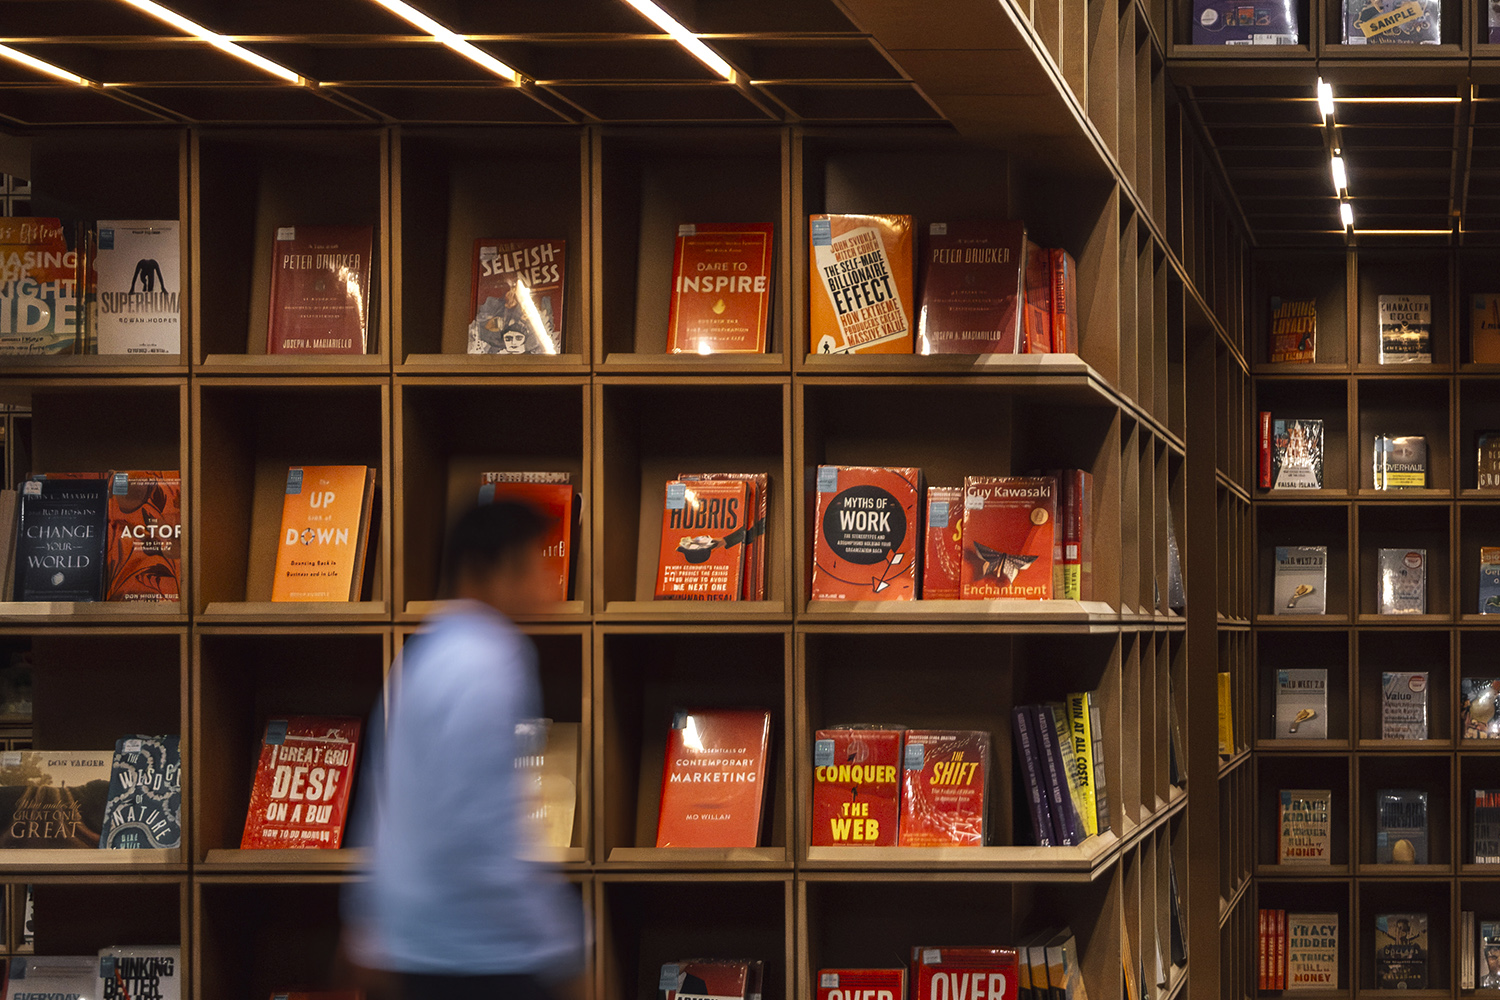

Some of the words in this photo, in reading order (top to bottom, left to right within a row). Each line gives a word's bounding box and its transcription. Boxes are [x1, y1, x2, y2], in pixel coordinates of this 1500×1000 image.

[1370, 7, 1416, 33] SAMPLE
[283, 254, 313, 270] PETER
[316, 253, 361, 270] DRUCKER
[480, 243, 561, 277] SELFISH-
[697, 261, 730, 272] DARE
[732, 261, 748, 272] TO
[823, 264, 844, 278] THE
[845, 250, 884, 272] SELF-MADE
[515, 264, 560, 287] NESS
[828, 262, 889, 292] BILLIONAIRE
[676, 275, 767, 294] INSPIRE
[832, 275, 894, 316] EFFECT
[1381, 302, 1429, 312] CHARACTER
[1273, 316, 1316, 334] LOYALTY
[309, 491, 335, 509] UP
[967, 486, 992, 501] Guy
[994, 486, 1051, 498] Kawasaki
[844, 498, 873, 509] MYTHS
[875, 498, 888, 509] OF
[669, 498, 739, 529] HUBRIS
[840, 511, 891, 532] WORK
[26, 525, 95, 540] CHANGE
[121, 525, 181, 539] ACTOR
[286, 528, 349, 546] DOWN
[46, 543, 72, 551] YOUR
[28, 555, 90, 569] WORLD
[963, 584, 1047, 596] Enchantment
[676, 759, 754, 767] CONTEMPORARY
[951, 751, 965, 762] THE
[670, 772, 756, 783] MARKETING
[816, 765, 896, 784] CONQUER
[929, 761, 979, 786] SHIFT
[842, 803, 868, 816] THE
[830, 818, 880, 840] WEB
[1291, 938, 1336, 948] KIDDER
[1294, 973, 1331, 982] MONEY
